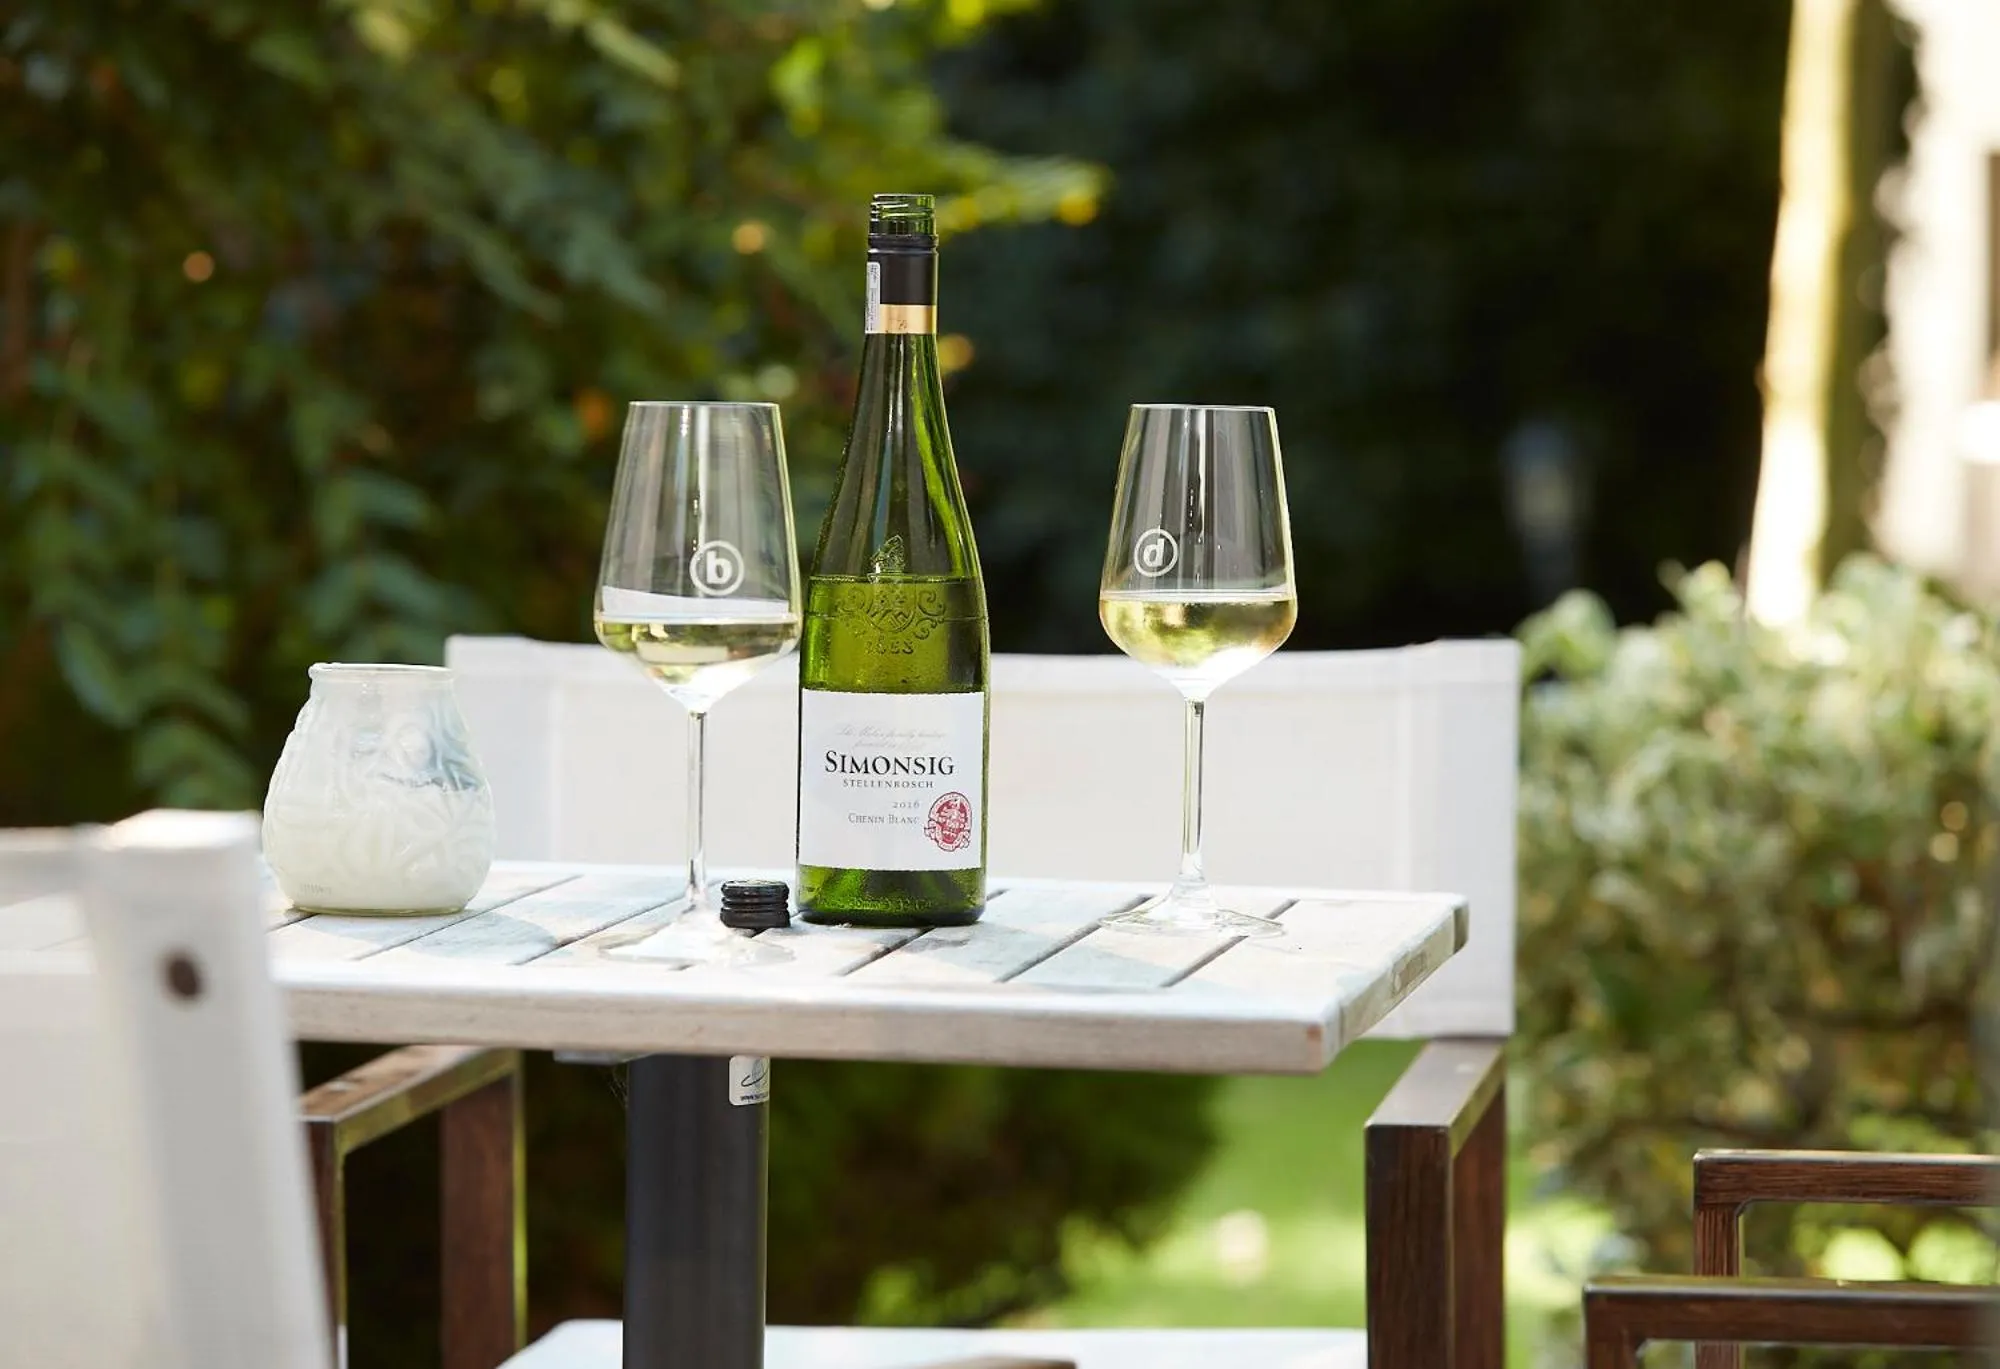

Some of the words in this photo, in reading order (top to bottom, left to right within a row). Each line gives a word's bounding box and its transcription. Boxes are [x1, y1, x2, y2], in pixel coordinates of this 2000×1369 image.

[706, 550, 733, 585] b
[825, 750, 955, 776] SIMONSIG
[843, 778, 934, 790] STELLENBOSCH
[892, 800, 920, 810] 2016
[848, 812, 885, 825] CHENIN
